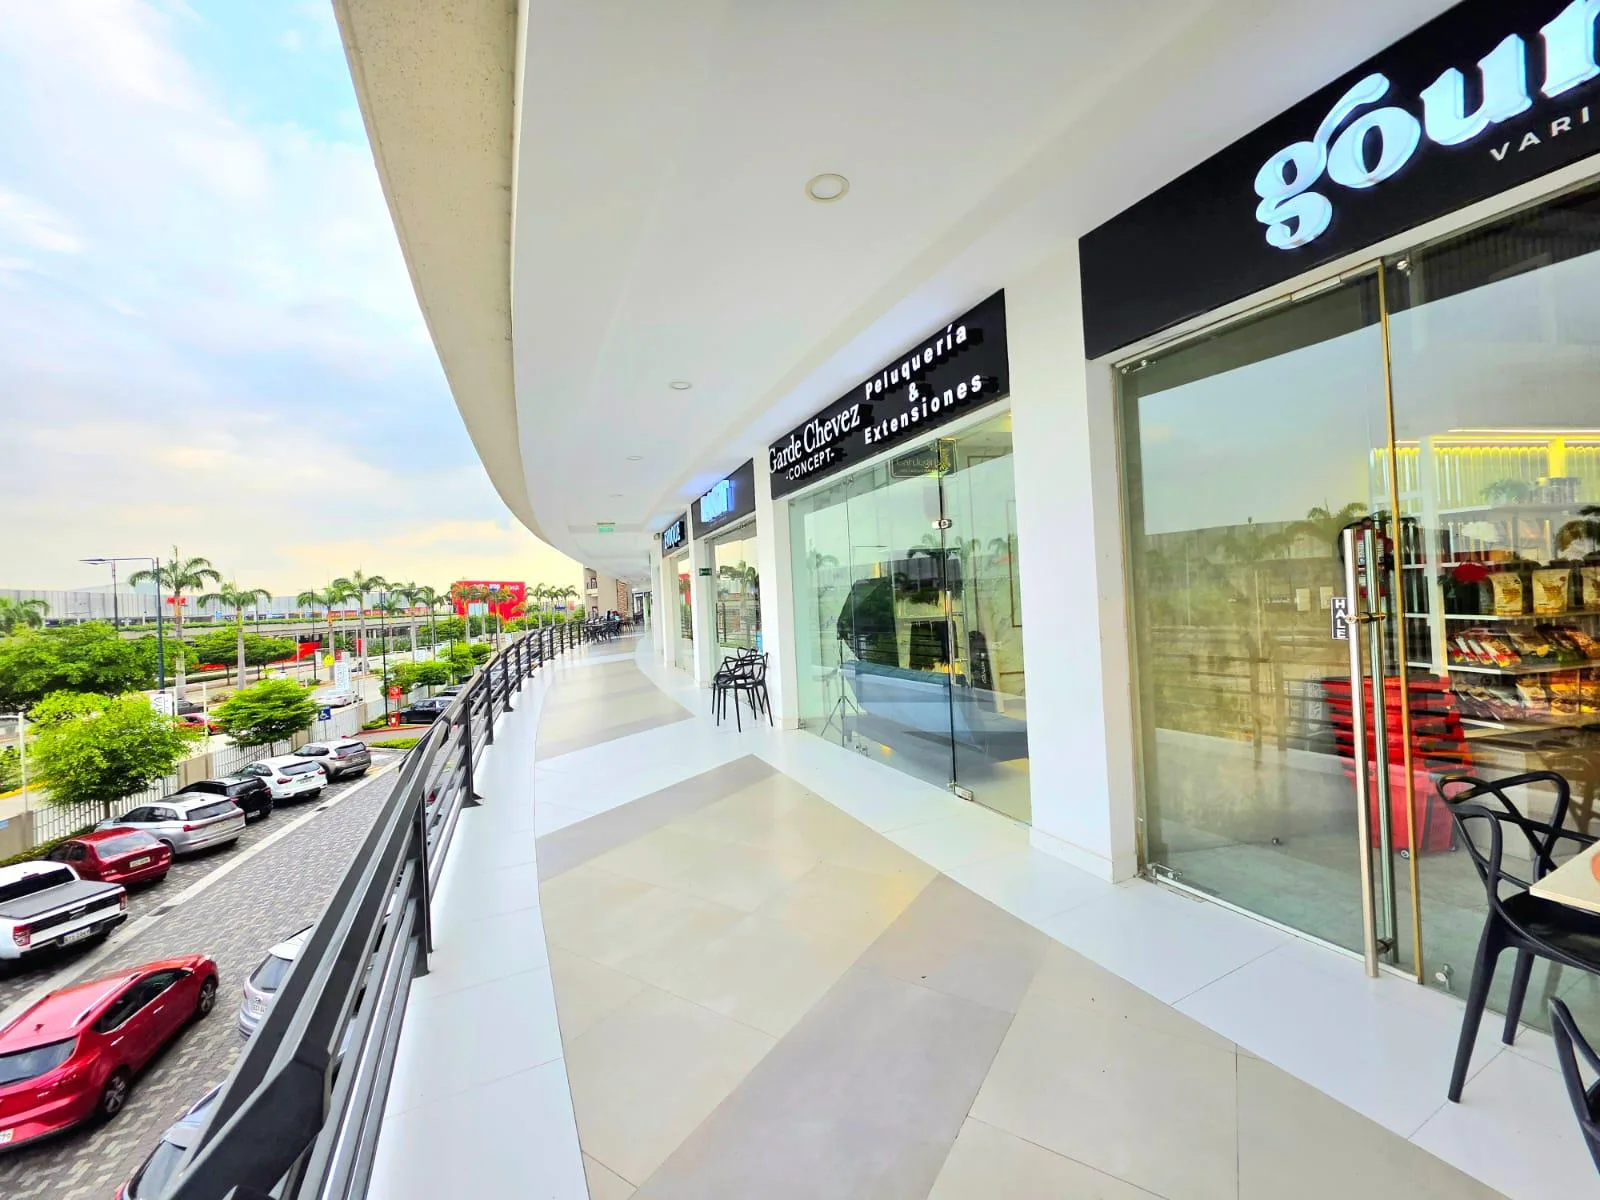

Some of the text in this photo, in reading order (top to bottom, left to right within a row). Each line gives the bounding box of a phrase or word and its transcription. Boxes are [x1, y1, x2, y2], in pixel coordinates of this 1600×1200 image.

[1490, 106, 1590, 161] VARI
[865, 323, 968, 400] Peluquería
[908, 381, 919, 402] &
[768, 403, 861, 473] Garde Chevez
[864, 373, 982, 445] Extensiones
[1335, 599, 1346, 638] HALE
